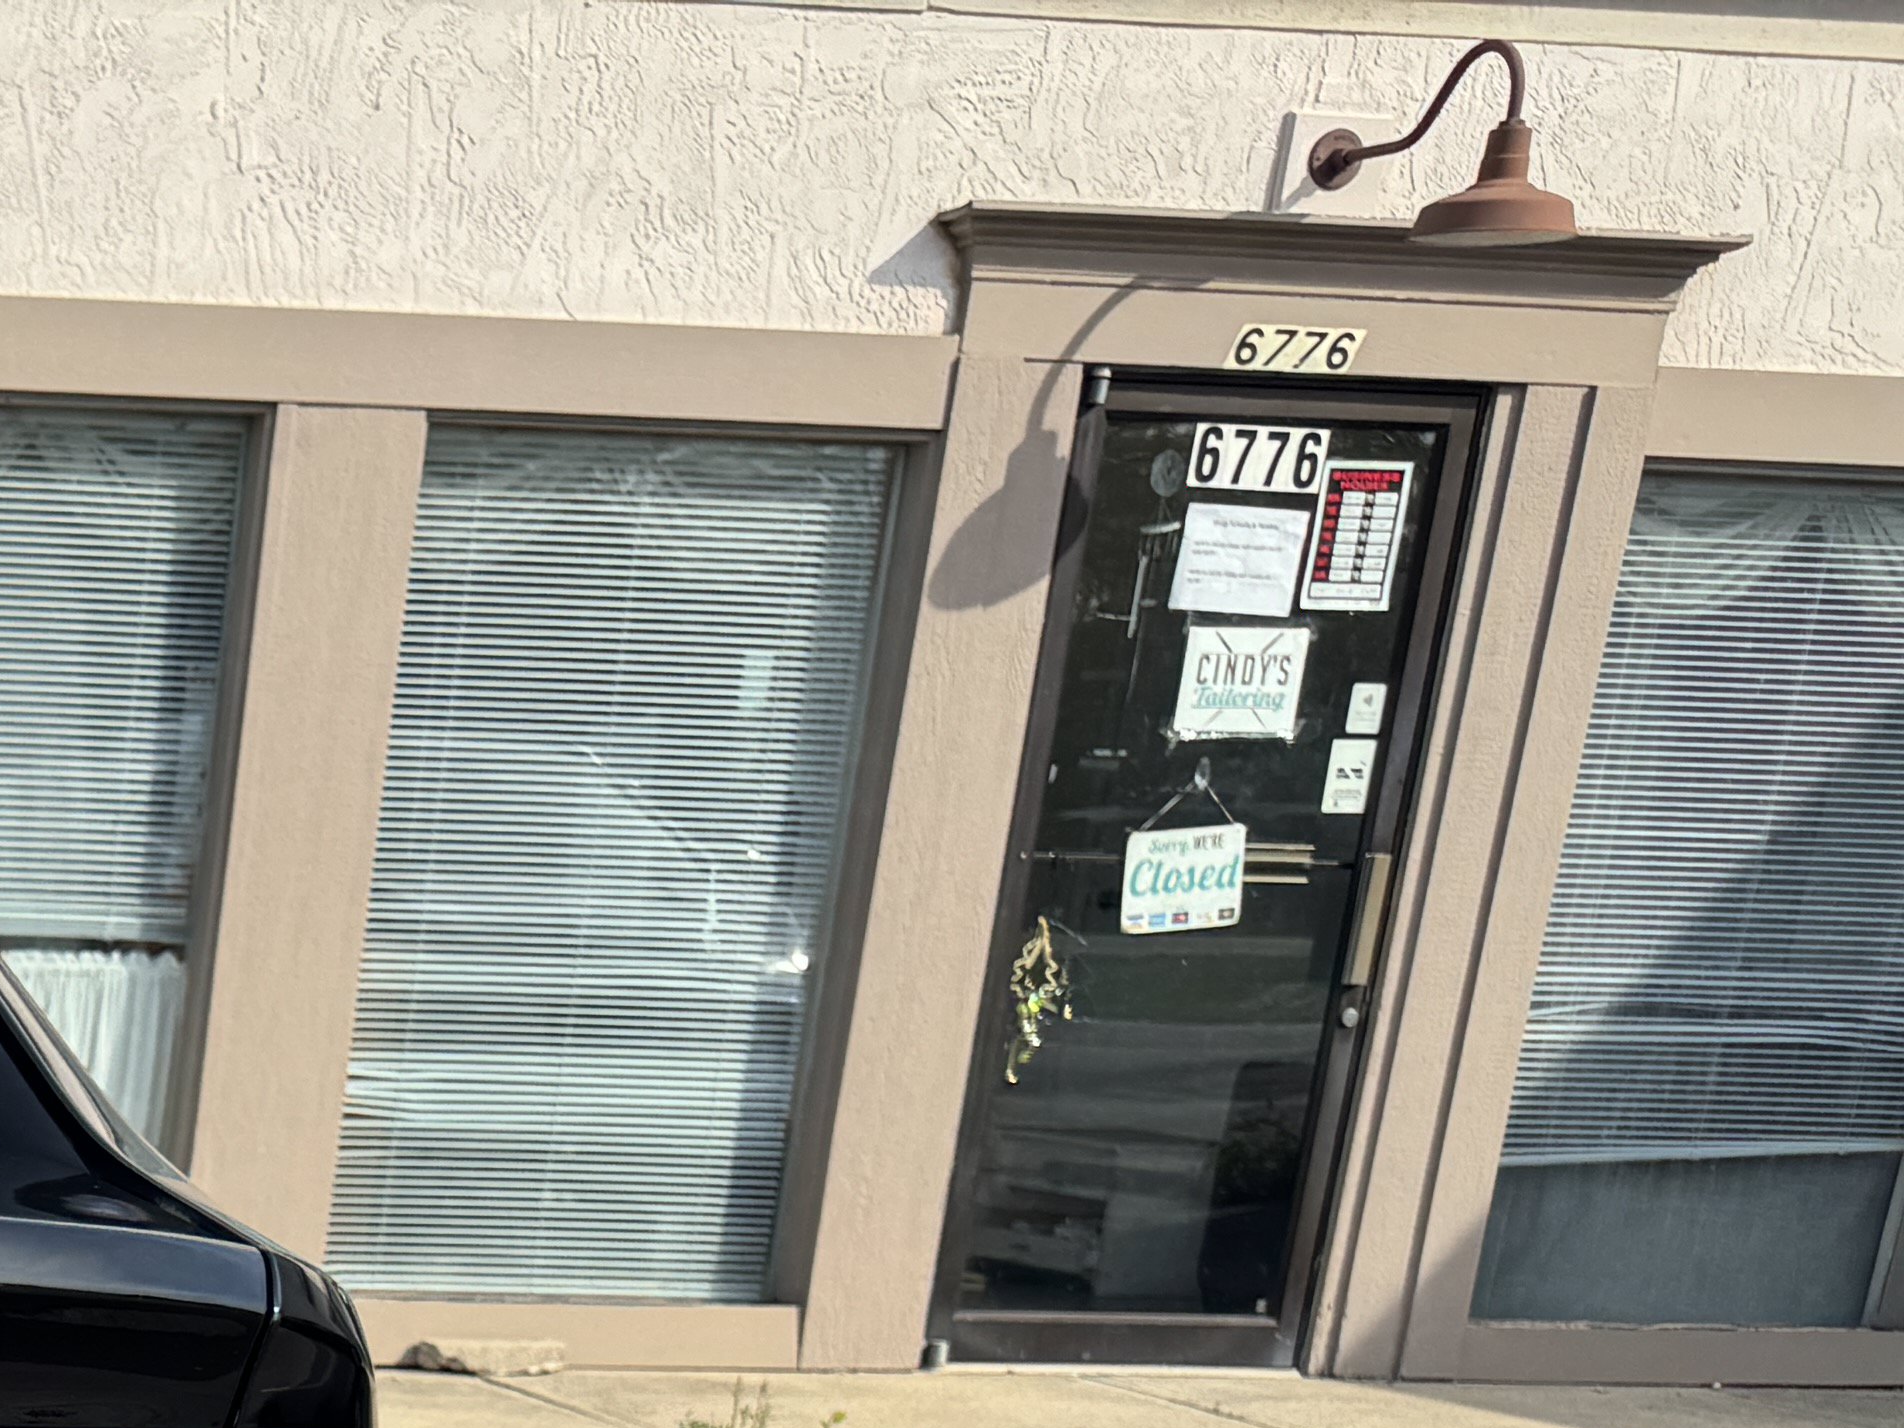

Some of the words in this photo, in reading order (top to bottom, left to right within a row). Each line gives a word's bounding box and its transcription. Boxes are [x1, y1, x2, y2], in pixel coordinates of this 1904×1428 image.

[1234, 327, 1356, 370] 6776
[1195, 426, 1322, 489] 6776
[1196, 653, 1292, 686] CINDY'S
[1192, 685, 1286, 712] Tailoring
[1129, 854, 1241, 897] Closed
